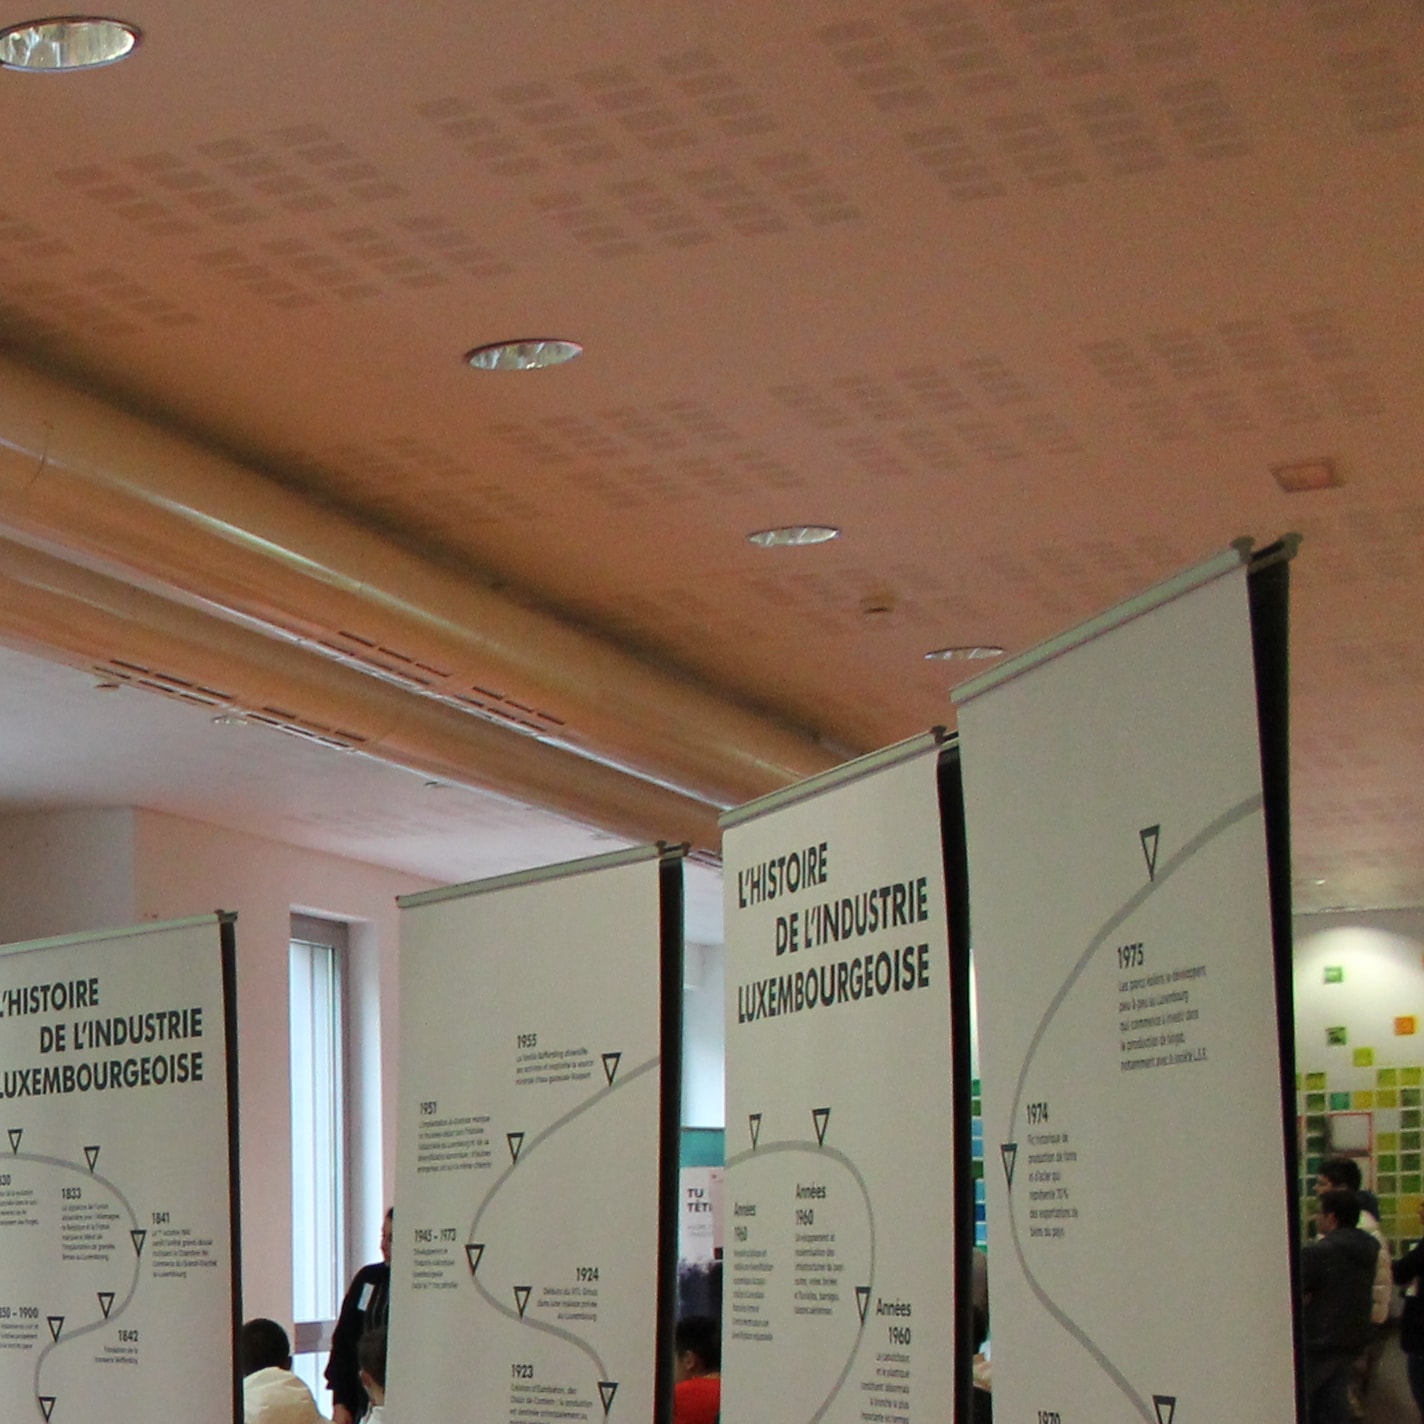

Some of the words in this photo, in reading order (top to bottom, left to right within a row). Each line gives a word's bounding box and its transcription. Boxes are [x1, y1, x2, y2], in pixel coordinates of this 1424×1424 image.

[738, 842, 828, 909] L'HISTOIRE
[775, 912, 799, 956] DE
[804, 877, 928, 949] L'INDUSTRIE
[1117, 942, 1145, 969] 1975
[738, 944, 929, 1024] LUXEMBOURGEOISE
[40, 1024, 66, 1054] DE
[74, 1007, 203, 1050] L'INDUSTRIE
[517, 1033, 538, 1048] 1955
[1026, 1102, 1049, 1125] 1974
[61, 1187, 82, 1200] 1833
[687, 1188, 704, 1199] TU
[795, 1182, 827, 1200] Années
[152, 1212, 170, 1225] 1841
[795, 1209, 814, 1226] 1960
[576, 1267, 599, 1282] 1924
[19, 1306, 39, 1319] 1900
[876, 1297, 912, 1317] Années
[118, 1329, 139, 1343] 1842
[888, 1326, 911, 1345] 1960
[511, 1363, 534, 1379] 1923
